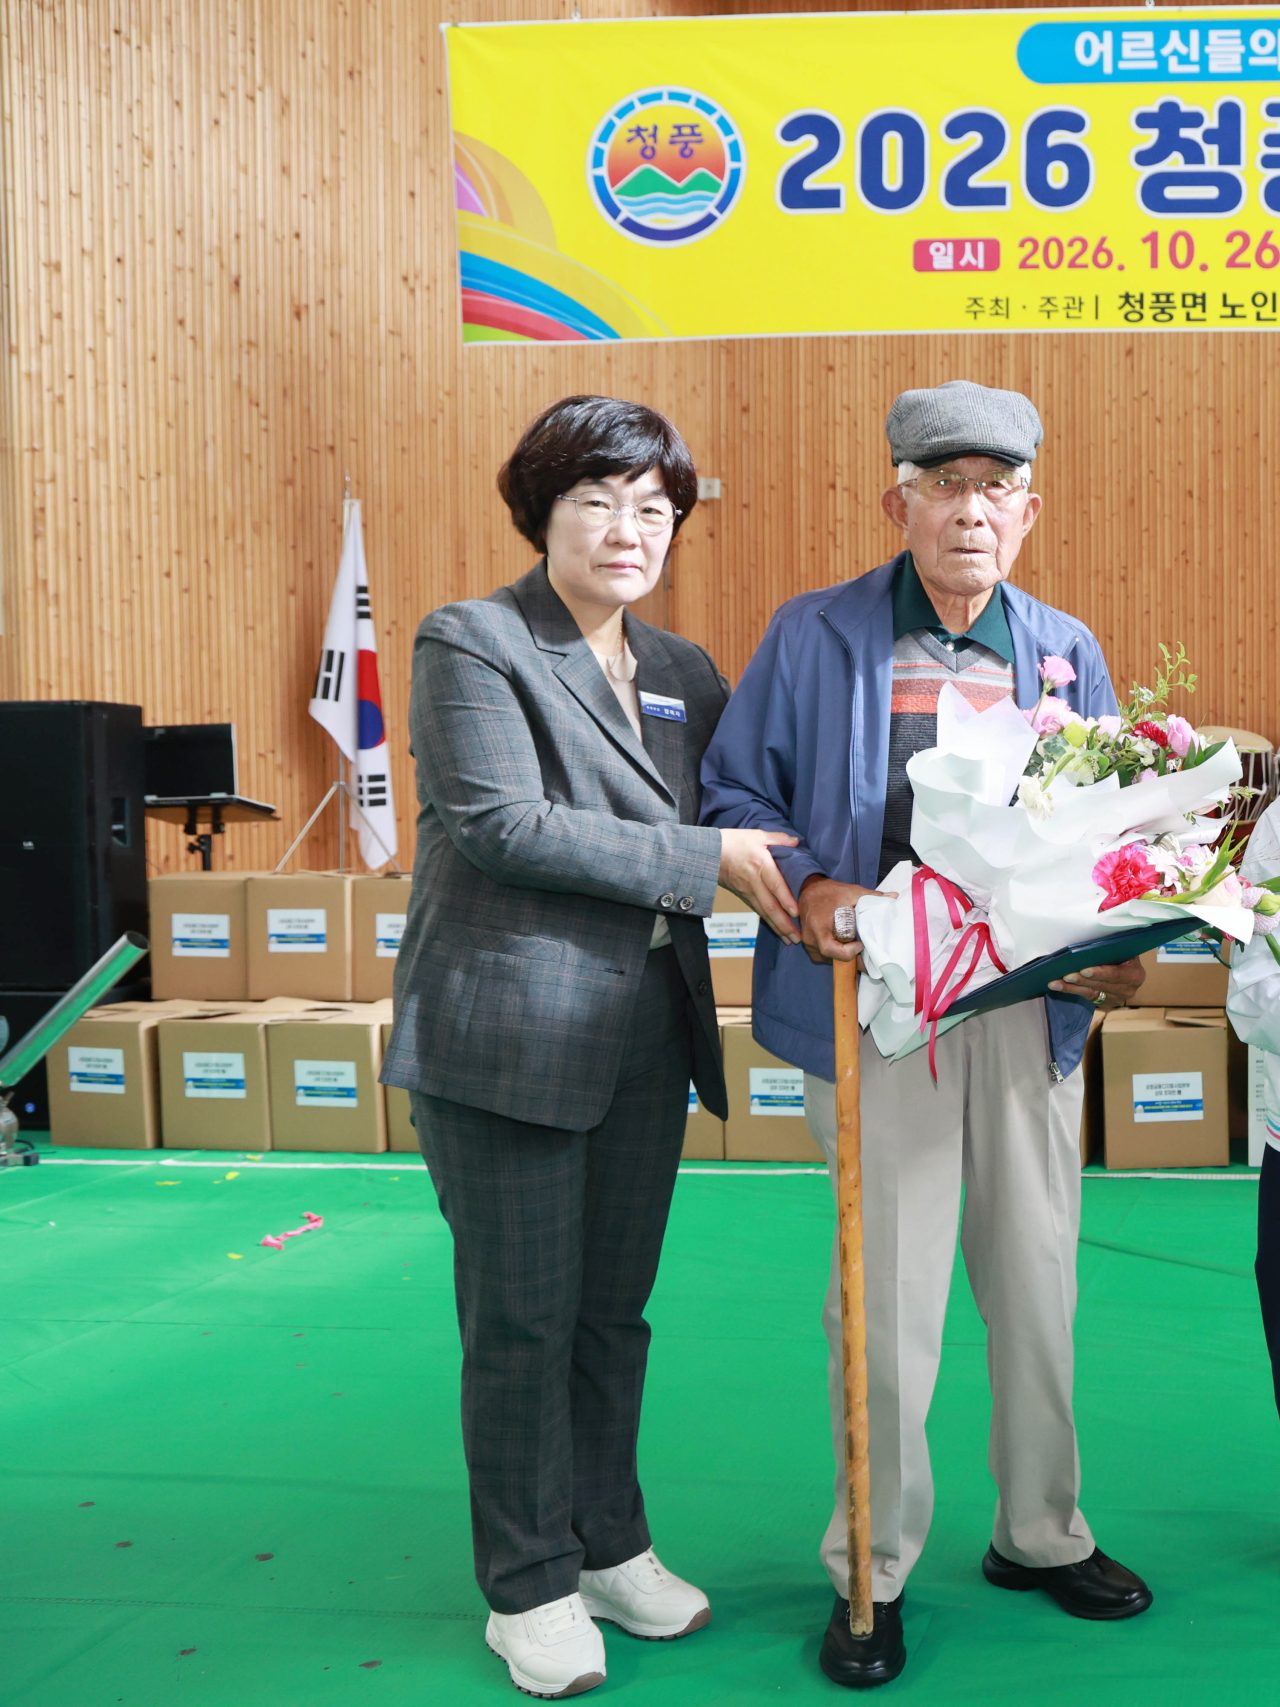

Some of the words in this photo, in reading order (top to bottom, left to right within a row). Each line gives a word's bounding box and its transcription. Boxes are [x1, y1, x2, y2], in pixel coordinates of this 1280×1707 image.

[626, 123, 705, 161] 청풍
[779, 109, 1091, 211] 2026
[928, 242, 986, 270] 일시
[1018, 236, 1126, 272] 2026.
[1141, 230, 1209, 272] 10.
[965, 296, 1010, 320] 주최
[1039, 295, 1084, 320] 주관
[1118, 291, 1207, 323] 청풍면
